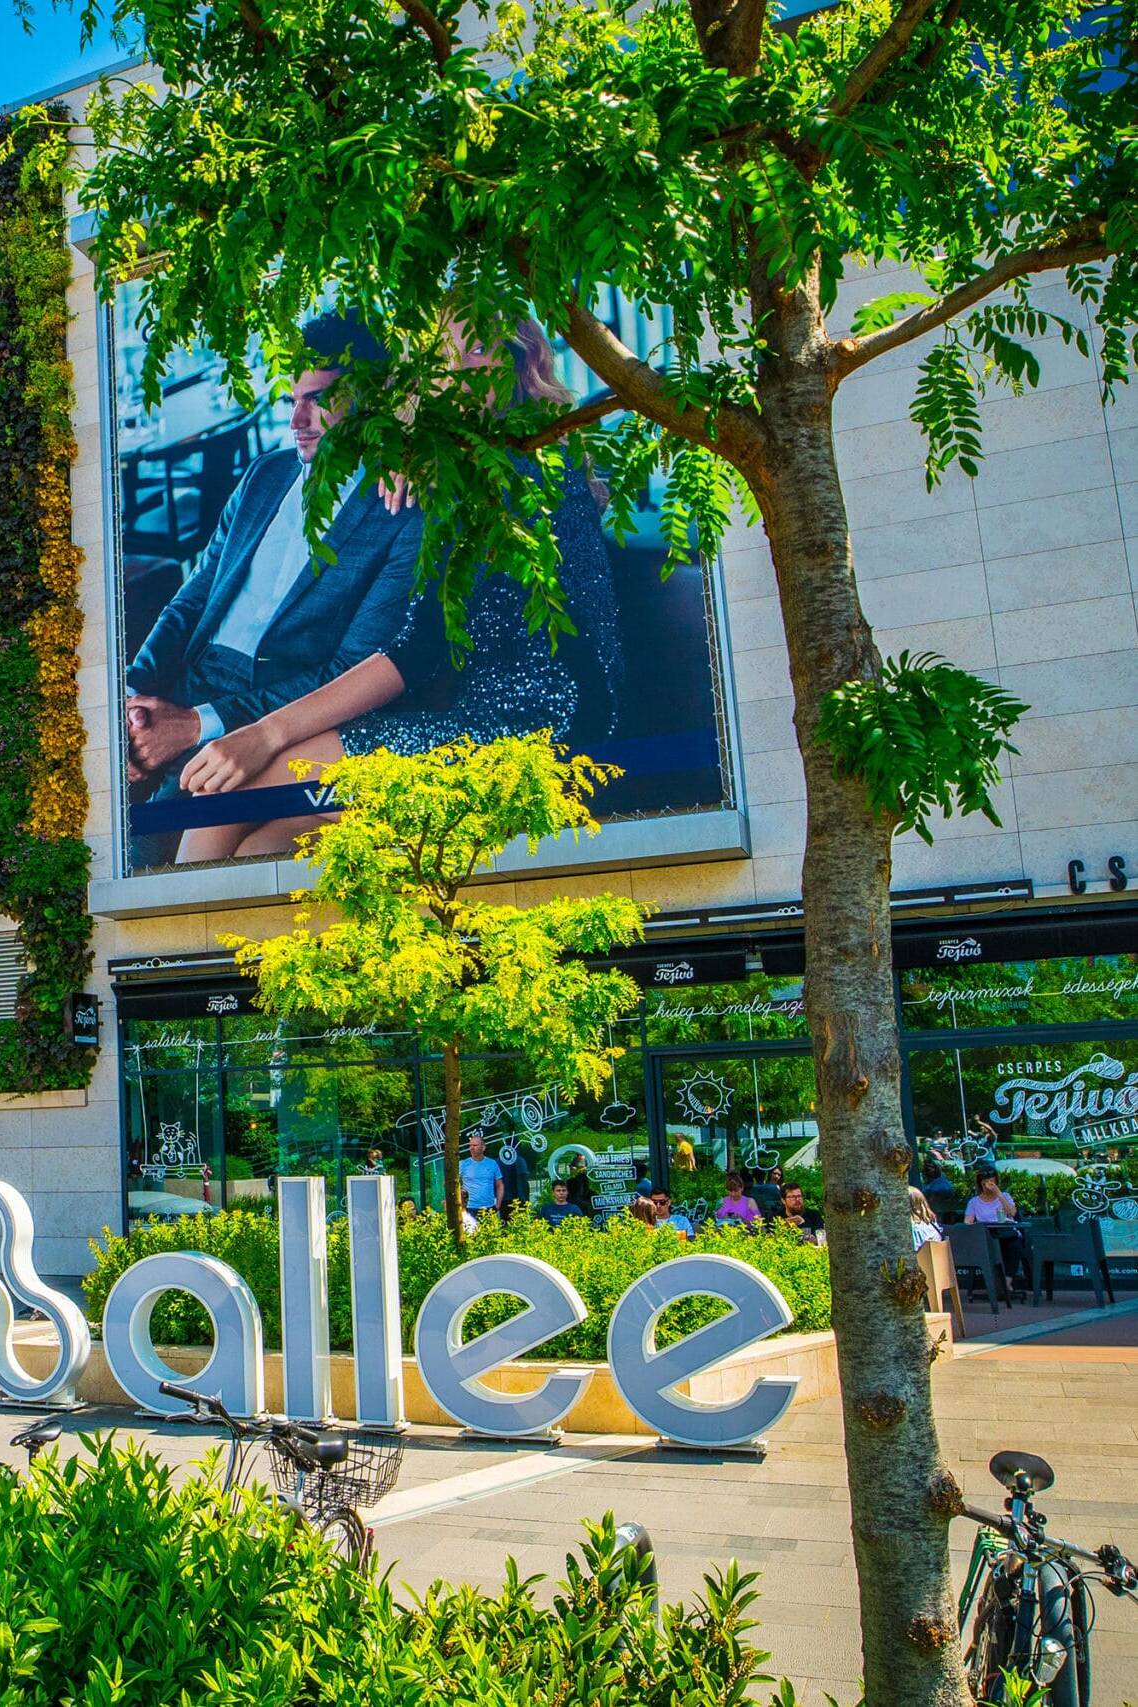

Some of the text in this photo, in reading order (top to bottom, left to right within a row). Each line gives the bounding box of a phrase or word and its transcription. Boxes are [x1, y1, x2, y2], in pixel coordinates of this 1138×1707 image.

[724, 995, 773, 1016] meleg
[997, 1060, 1062, 1075] CSERPES
[990, 1066, 1138, 1133] Tejivó
[103, 1176, 802, 1449] allee
